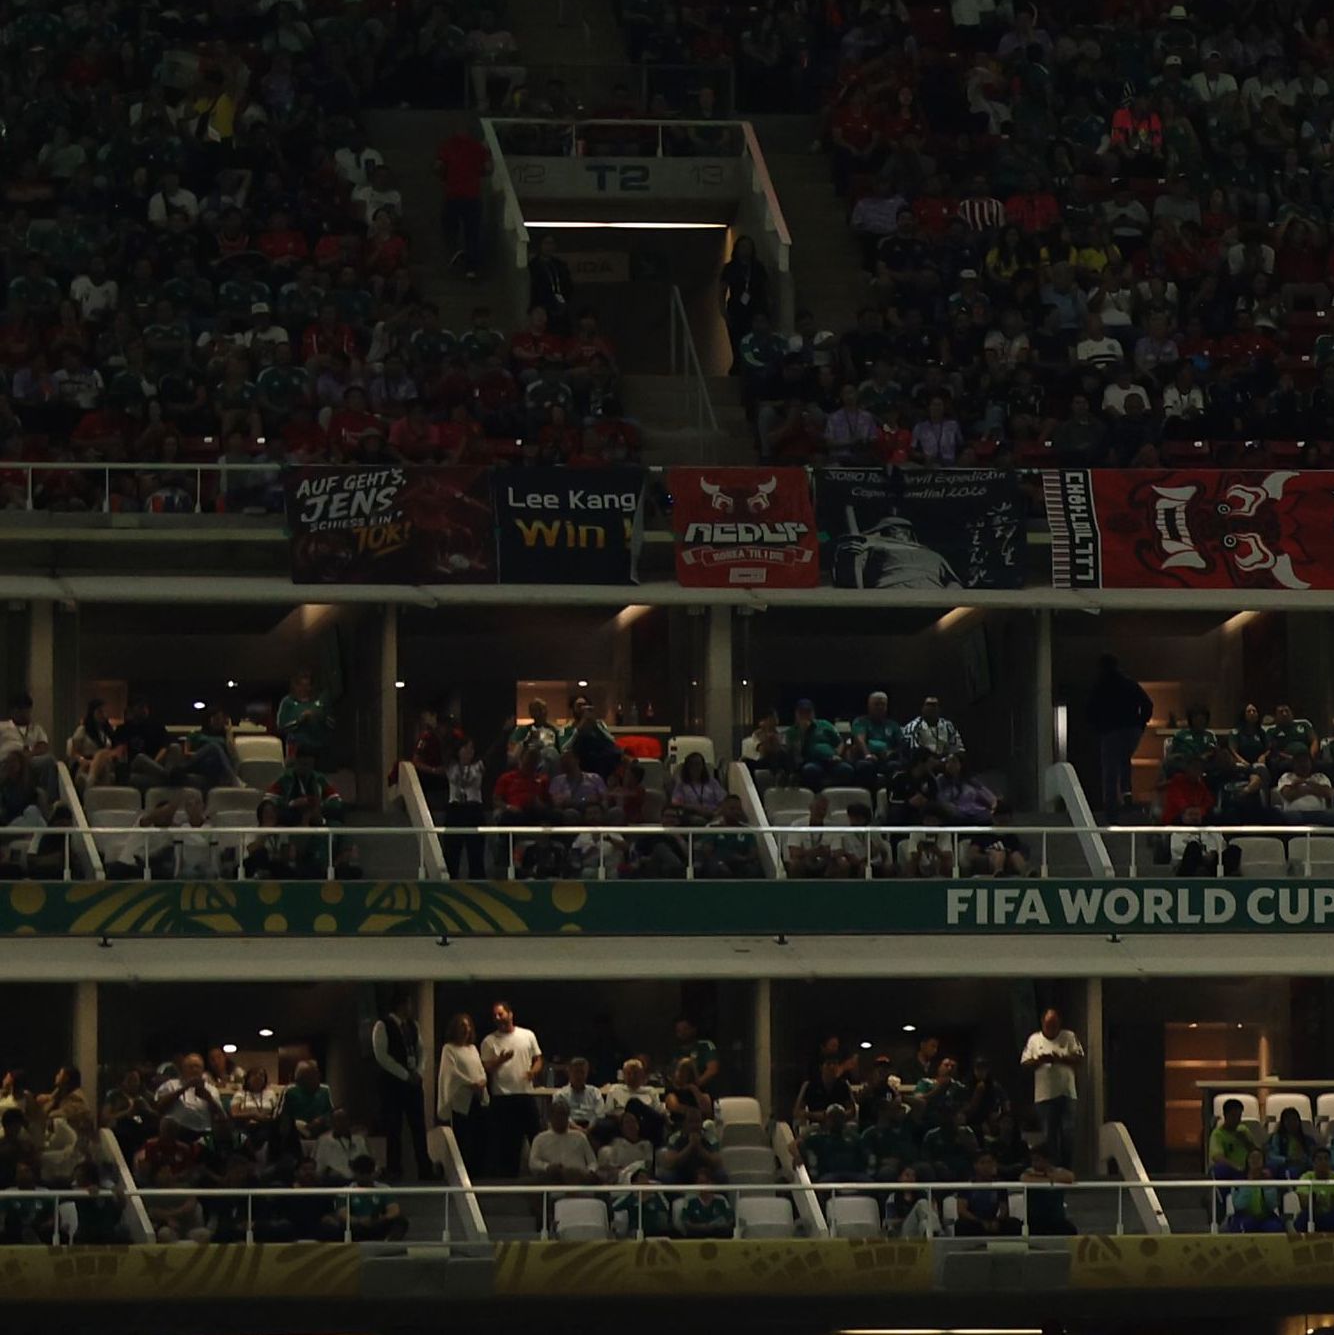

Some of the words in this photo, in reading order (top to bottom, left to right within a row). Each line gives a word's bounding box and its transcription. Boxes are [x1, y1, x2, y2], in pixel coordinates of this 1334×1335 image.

[586, 165, 650, 191] T2
[297, 476, 340, 499] AUF
[508, 486, 560, 510] Lee
[568, 489, 637, 513] Kang
[301, 486, 398, 522] JENS
[515, 517, 607, 549] Win
[946, 888, 1050, 924] FIFA
[1058, 887, 1237, 924] WORLD
